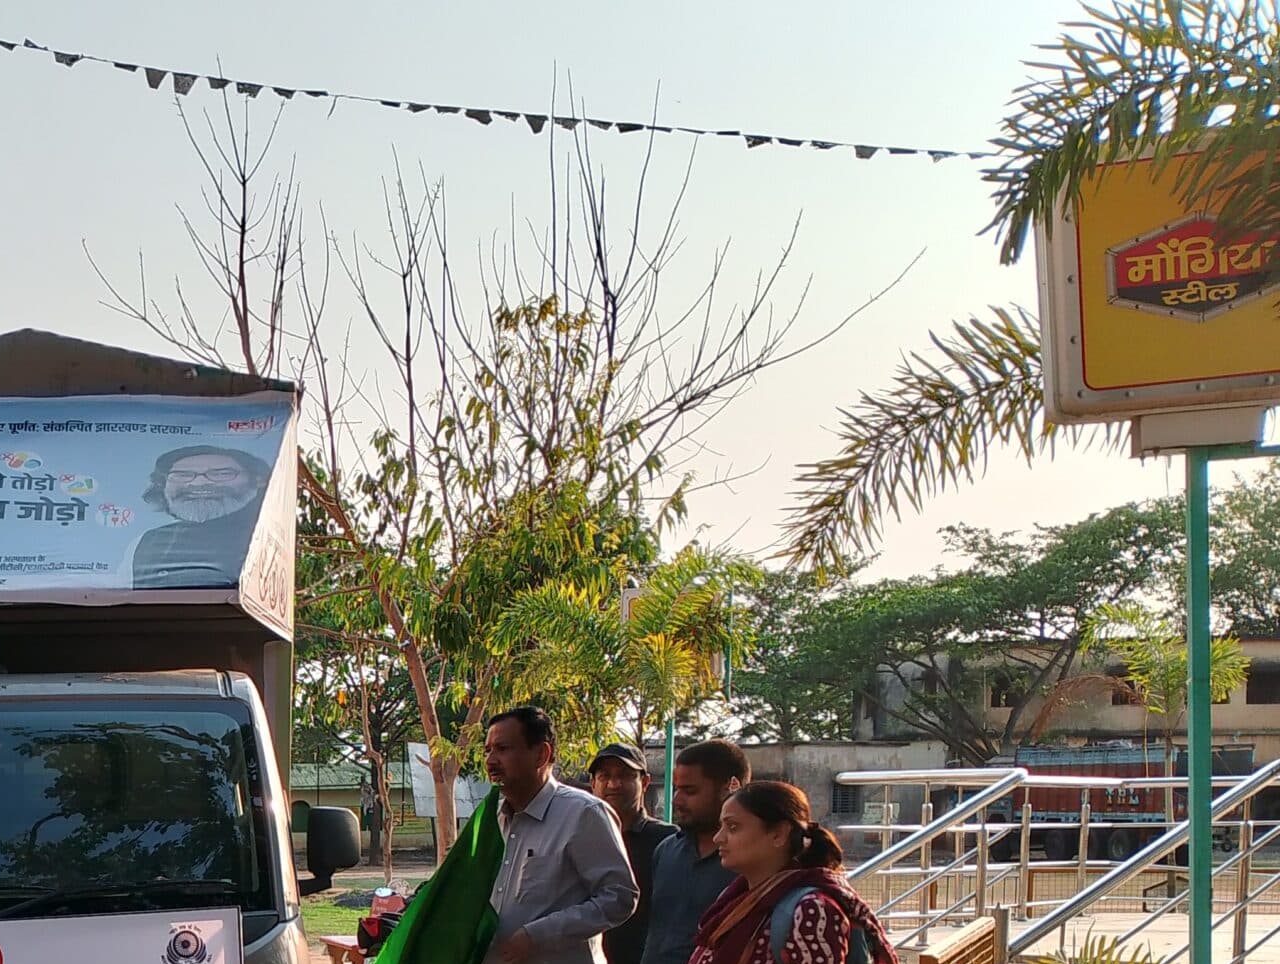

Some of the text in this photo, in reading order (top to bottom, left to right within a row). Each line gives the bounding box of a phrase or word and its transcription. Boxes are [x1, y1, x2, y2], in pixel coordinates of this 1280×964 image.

[1160, 281, 1240, 305] स्टील
[42, 420, 93, 433] संकल्पित
[96, 422, 147, 433] झारखण्ड
[10, 472, 57, 493] तोड़ो
[14, 497, 89, 526] जोड़ो
